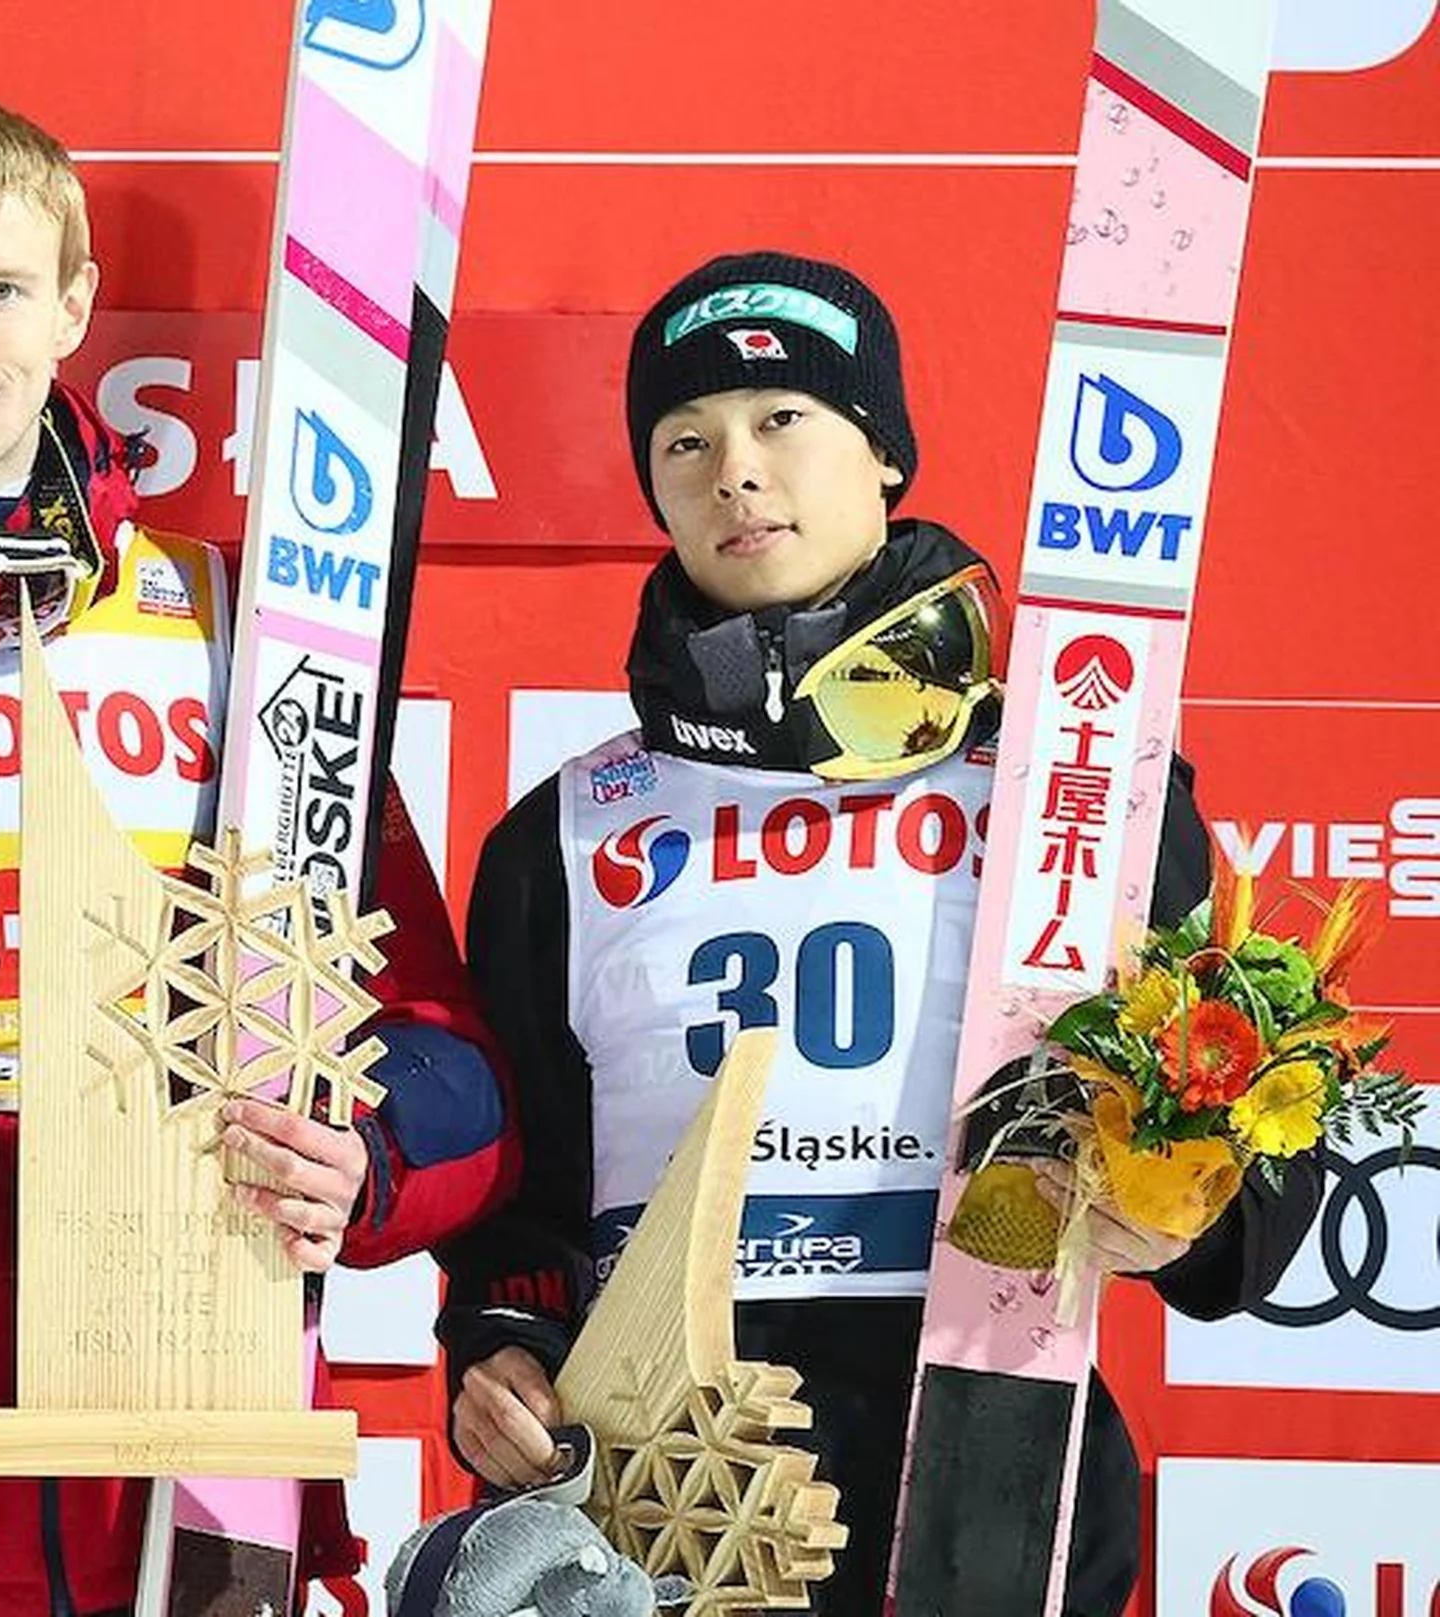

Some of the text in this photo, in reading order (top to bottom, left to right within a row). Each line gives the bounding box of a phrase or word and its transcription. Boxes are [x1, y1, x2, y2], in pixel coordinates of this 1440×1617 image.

[1037, 502, 1193, 562] BWT
[266, 534, 382, 611] BWT
[670, 714, 757, 754] uvex
[1021, 722, 1116, 973] 土屋ホーム
[686, 920, 896, 1078] 30
[750, 1120, 936, 1170] Śląskie.
